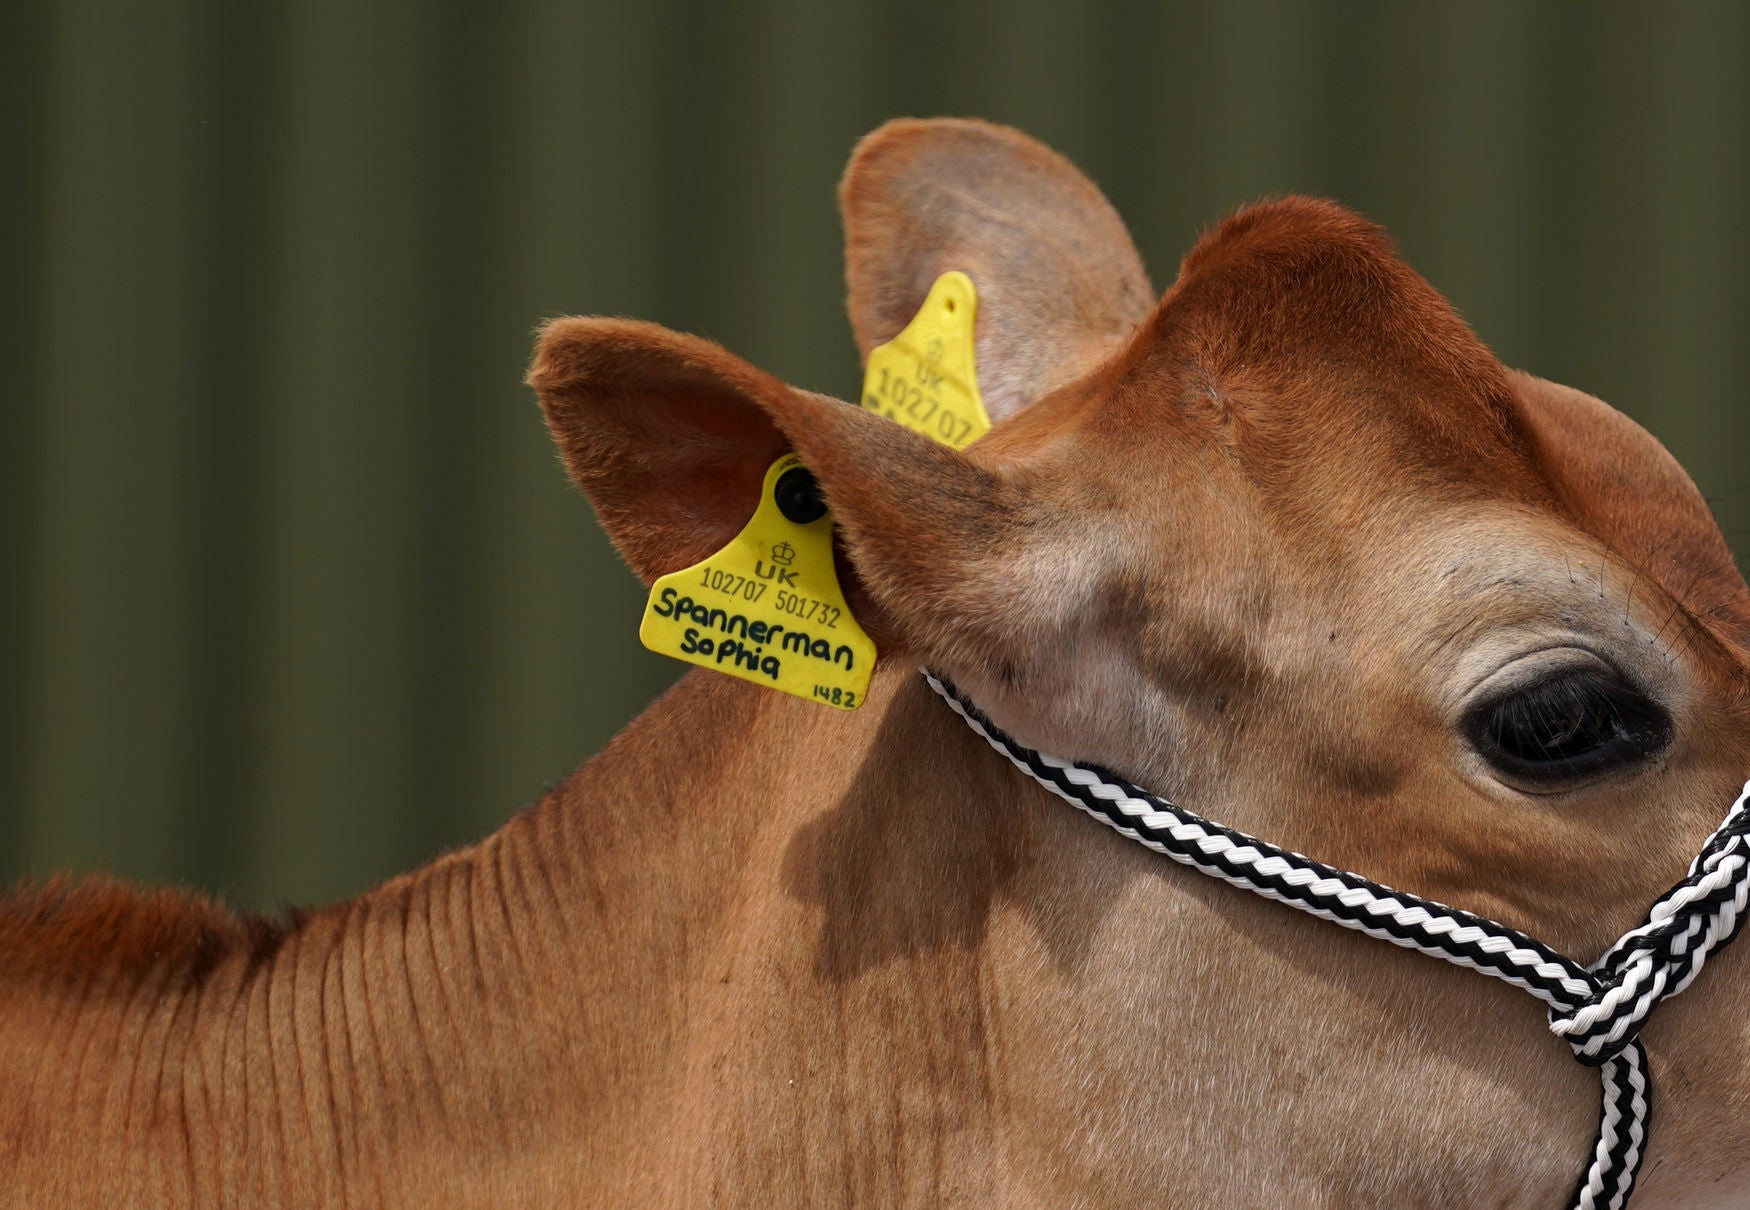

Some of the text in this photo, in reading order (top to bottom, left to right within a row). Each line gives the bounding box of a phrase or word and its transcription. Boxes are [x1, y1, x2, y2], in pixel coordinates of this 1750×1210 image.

[917, 363, 944, 394] UK
[879, 369, 973, 444] 102707
[700, 567, 840, 629] 102707 501732
[754, 560, 800, 588] UK
[654, 588, 854, 670] Spannerman
[680, 629, 780, 680] Sophia
[814, 684, 856, 708] 1482
